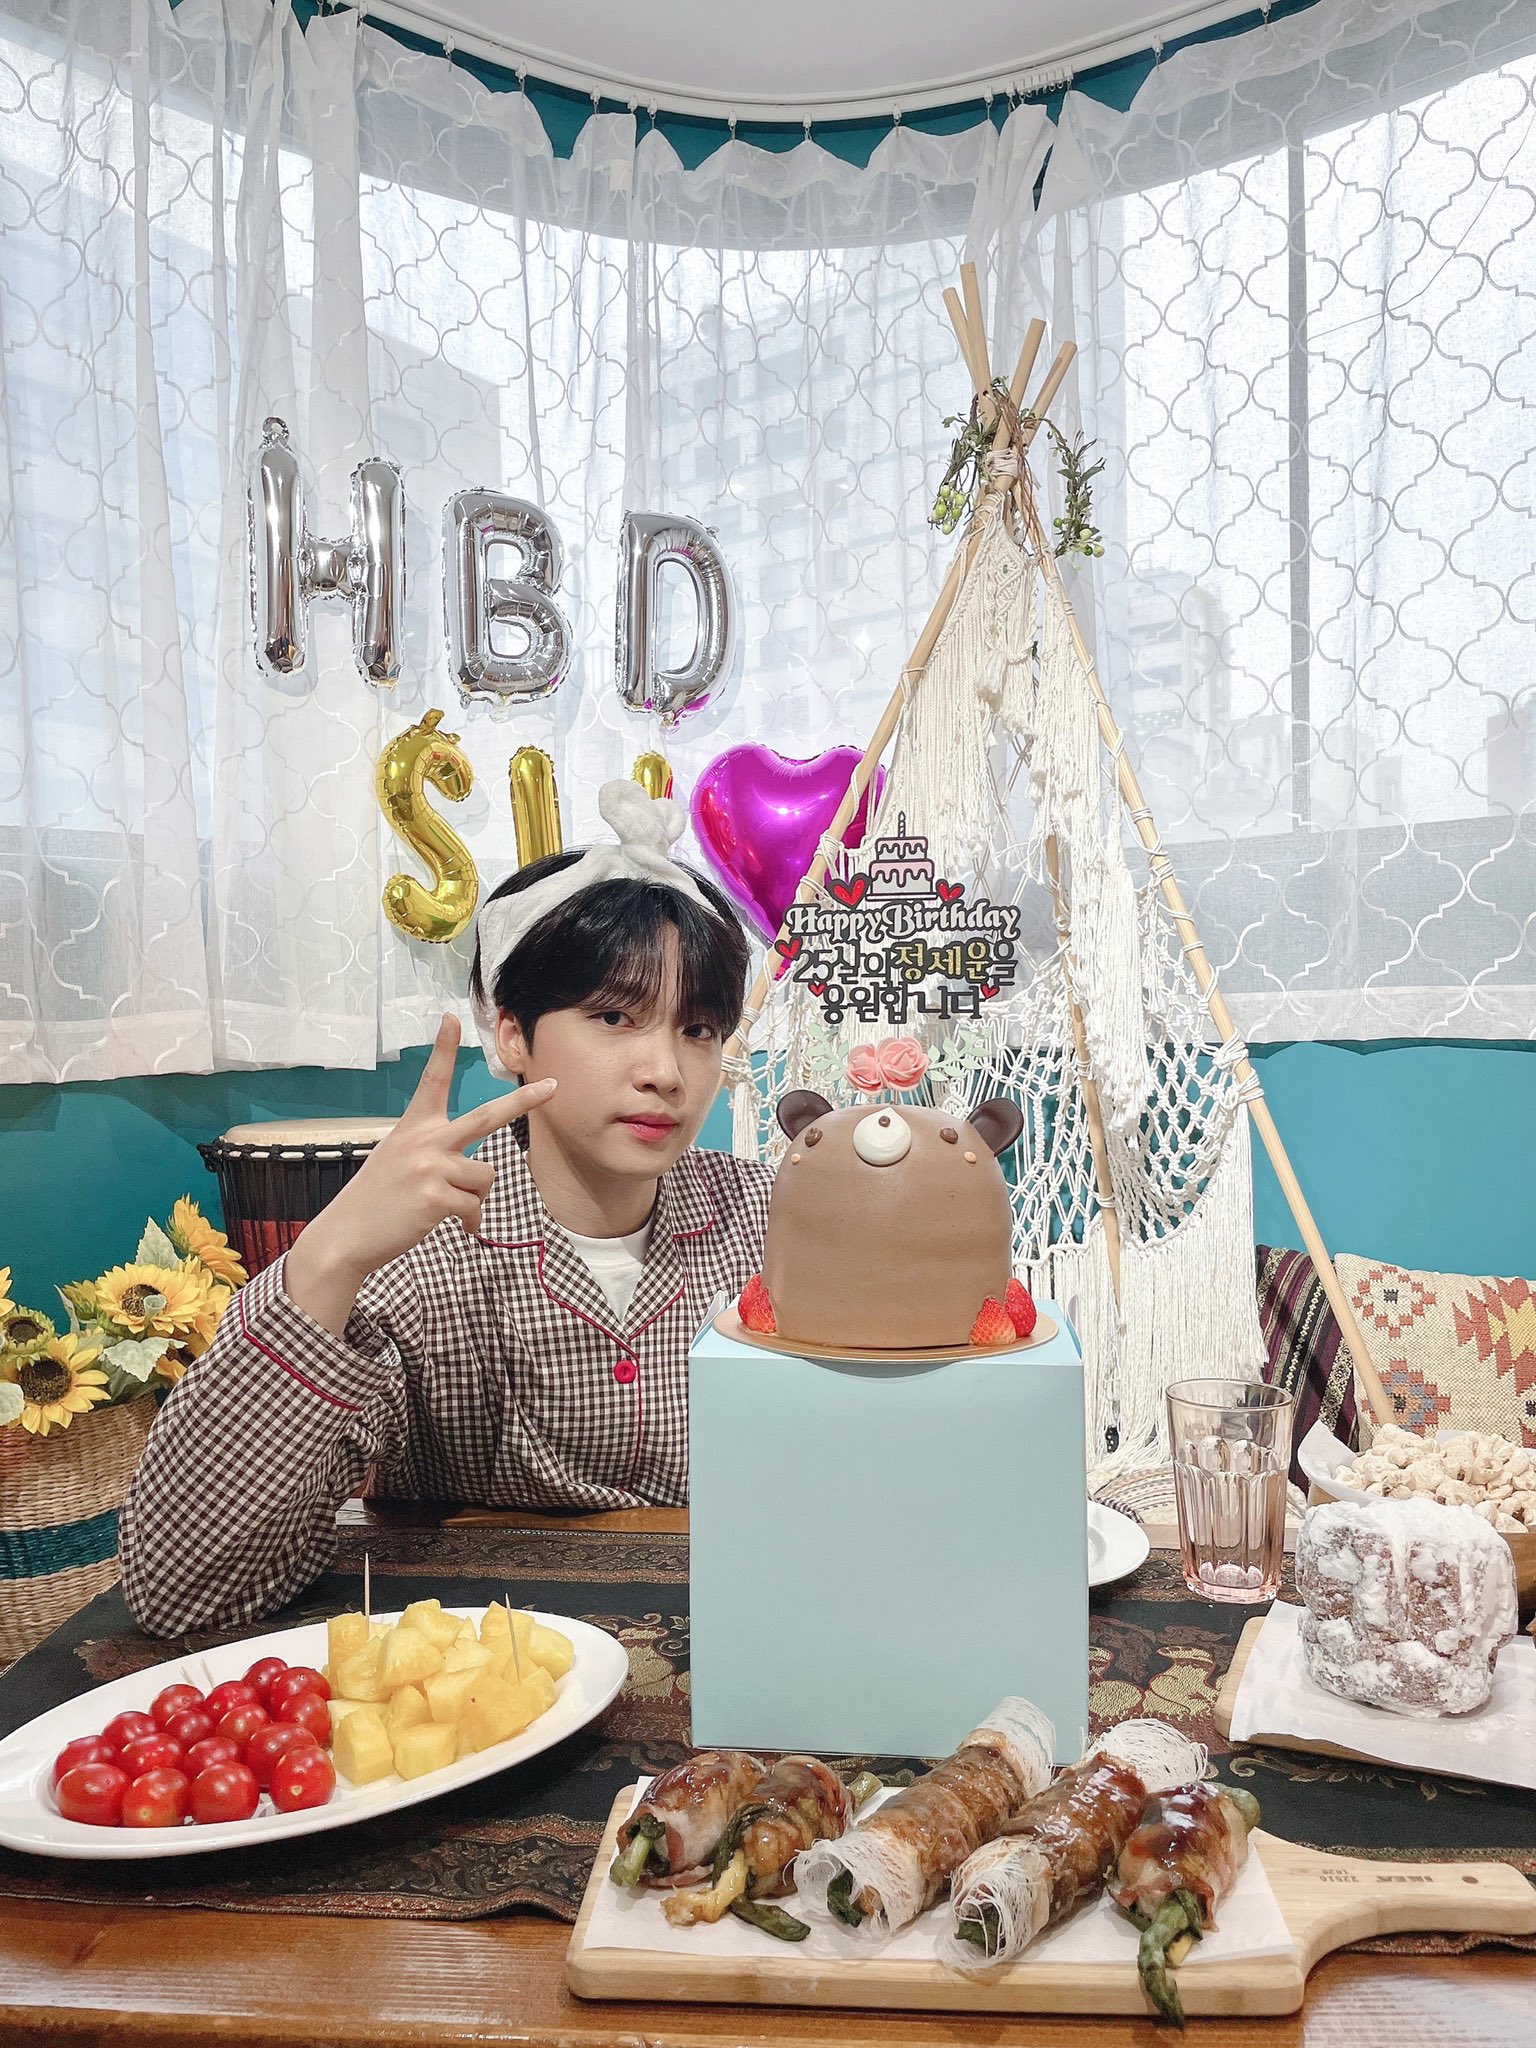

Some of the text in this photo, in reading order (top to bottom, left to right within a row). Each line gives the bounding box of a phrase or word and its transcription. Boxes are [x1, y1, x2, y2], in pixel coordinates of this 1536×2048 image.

[249, 420, 739, 730] HBD
[786, 899, 1020, 942] Happy Birthday
[793, 937, 1018, 986] 25살의 정세운을
[820, 981, 986, 1024] 응원합니다
